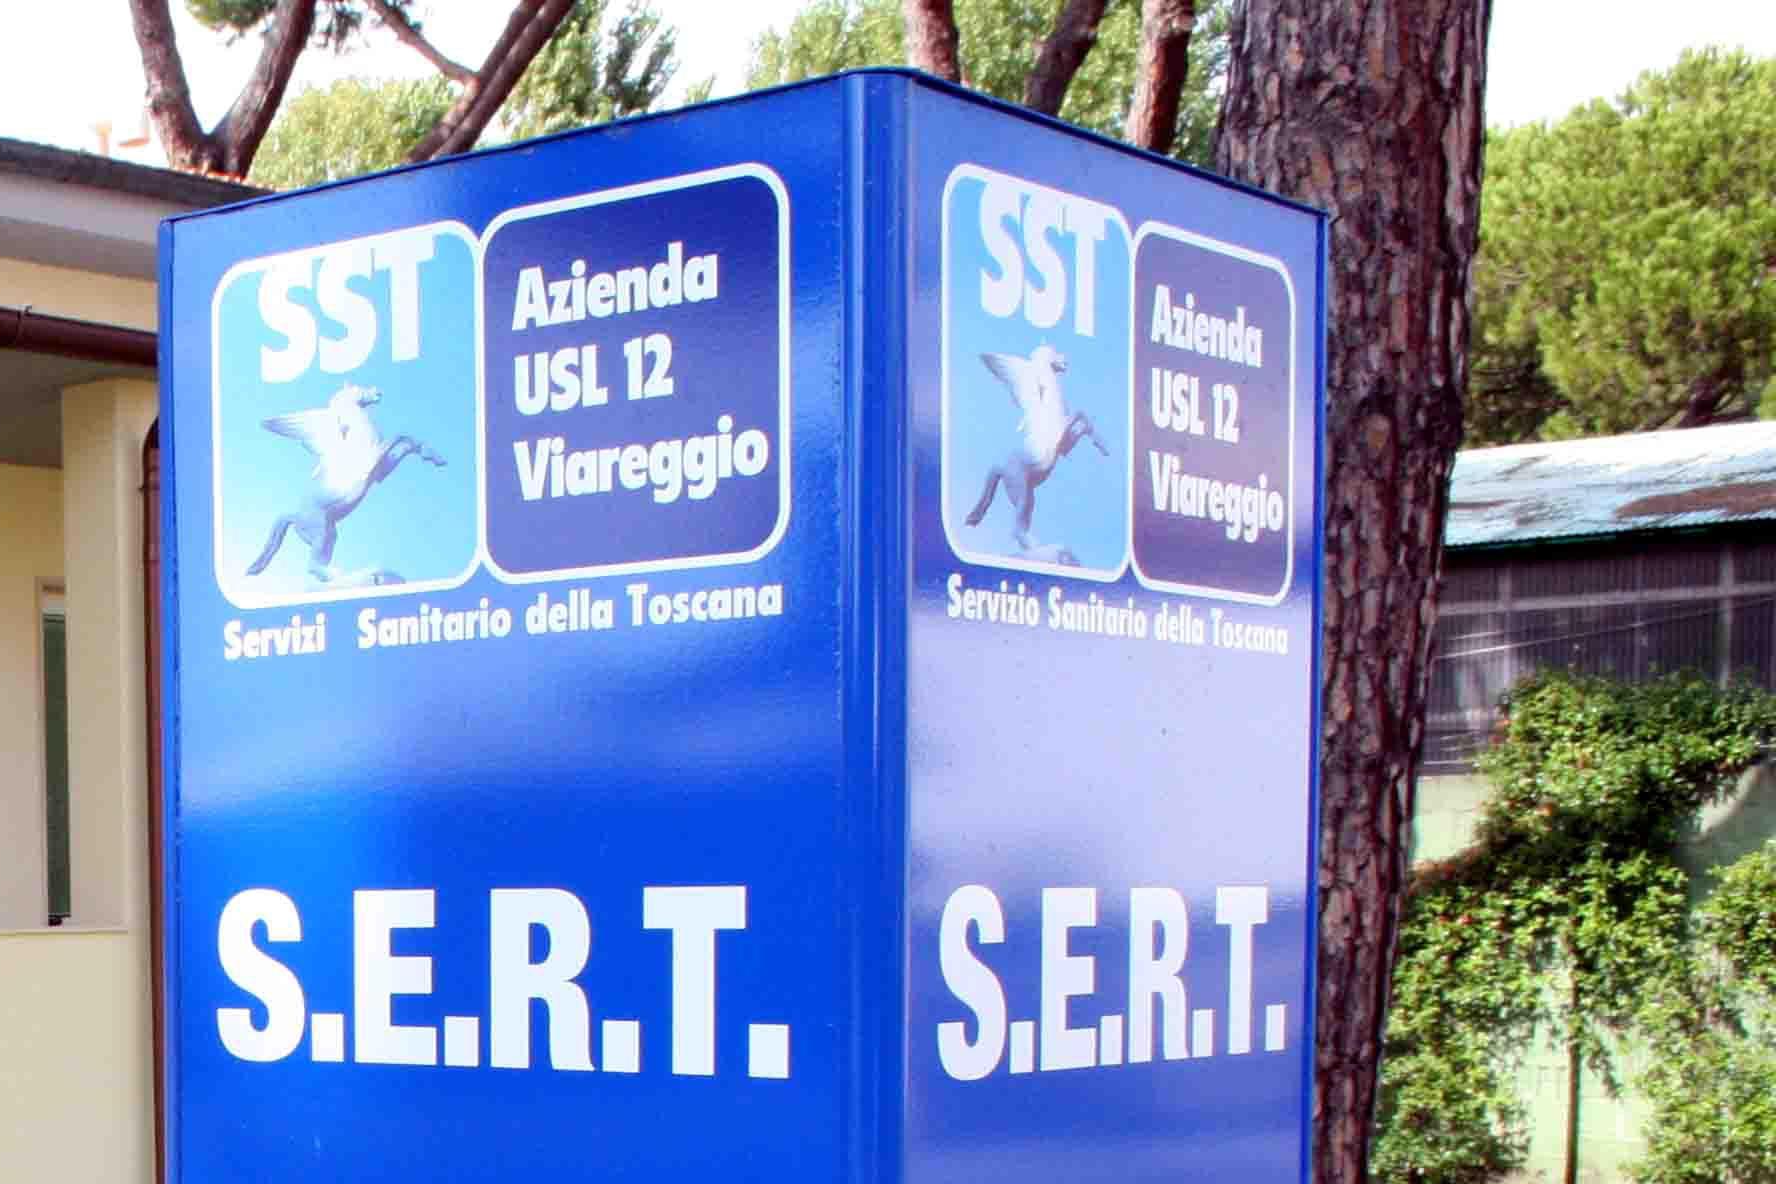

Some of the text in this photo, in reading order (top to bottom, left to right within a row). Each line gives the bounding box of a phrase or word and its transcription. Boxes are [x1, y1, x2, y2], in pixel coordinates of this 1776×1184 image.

[511, 240, 718, 330] Azienda
[979, 180, 1105, 337] SST
[257, 236, 435, 384] SST
[1150, 284, 1264, 369] Azienda
[513, 332, 675, 416] USL 12
[1150, 367, 1241, 443] USL 12
[512, 414, 770, 504] Viareggio
[1149, 450, 1285, 544] Viareggio
[223, 580, 784, 661] Servizi Sanitario della Toscana
[946, 572, 1290, 655] Servizio Sanitario della Toscana
[216, 885, 790, 1080] S.E.R.T.
[936, 882, 1287, 1081] S.E.R.T.
